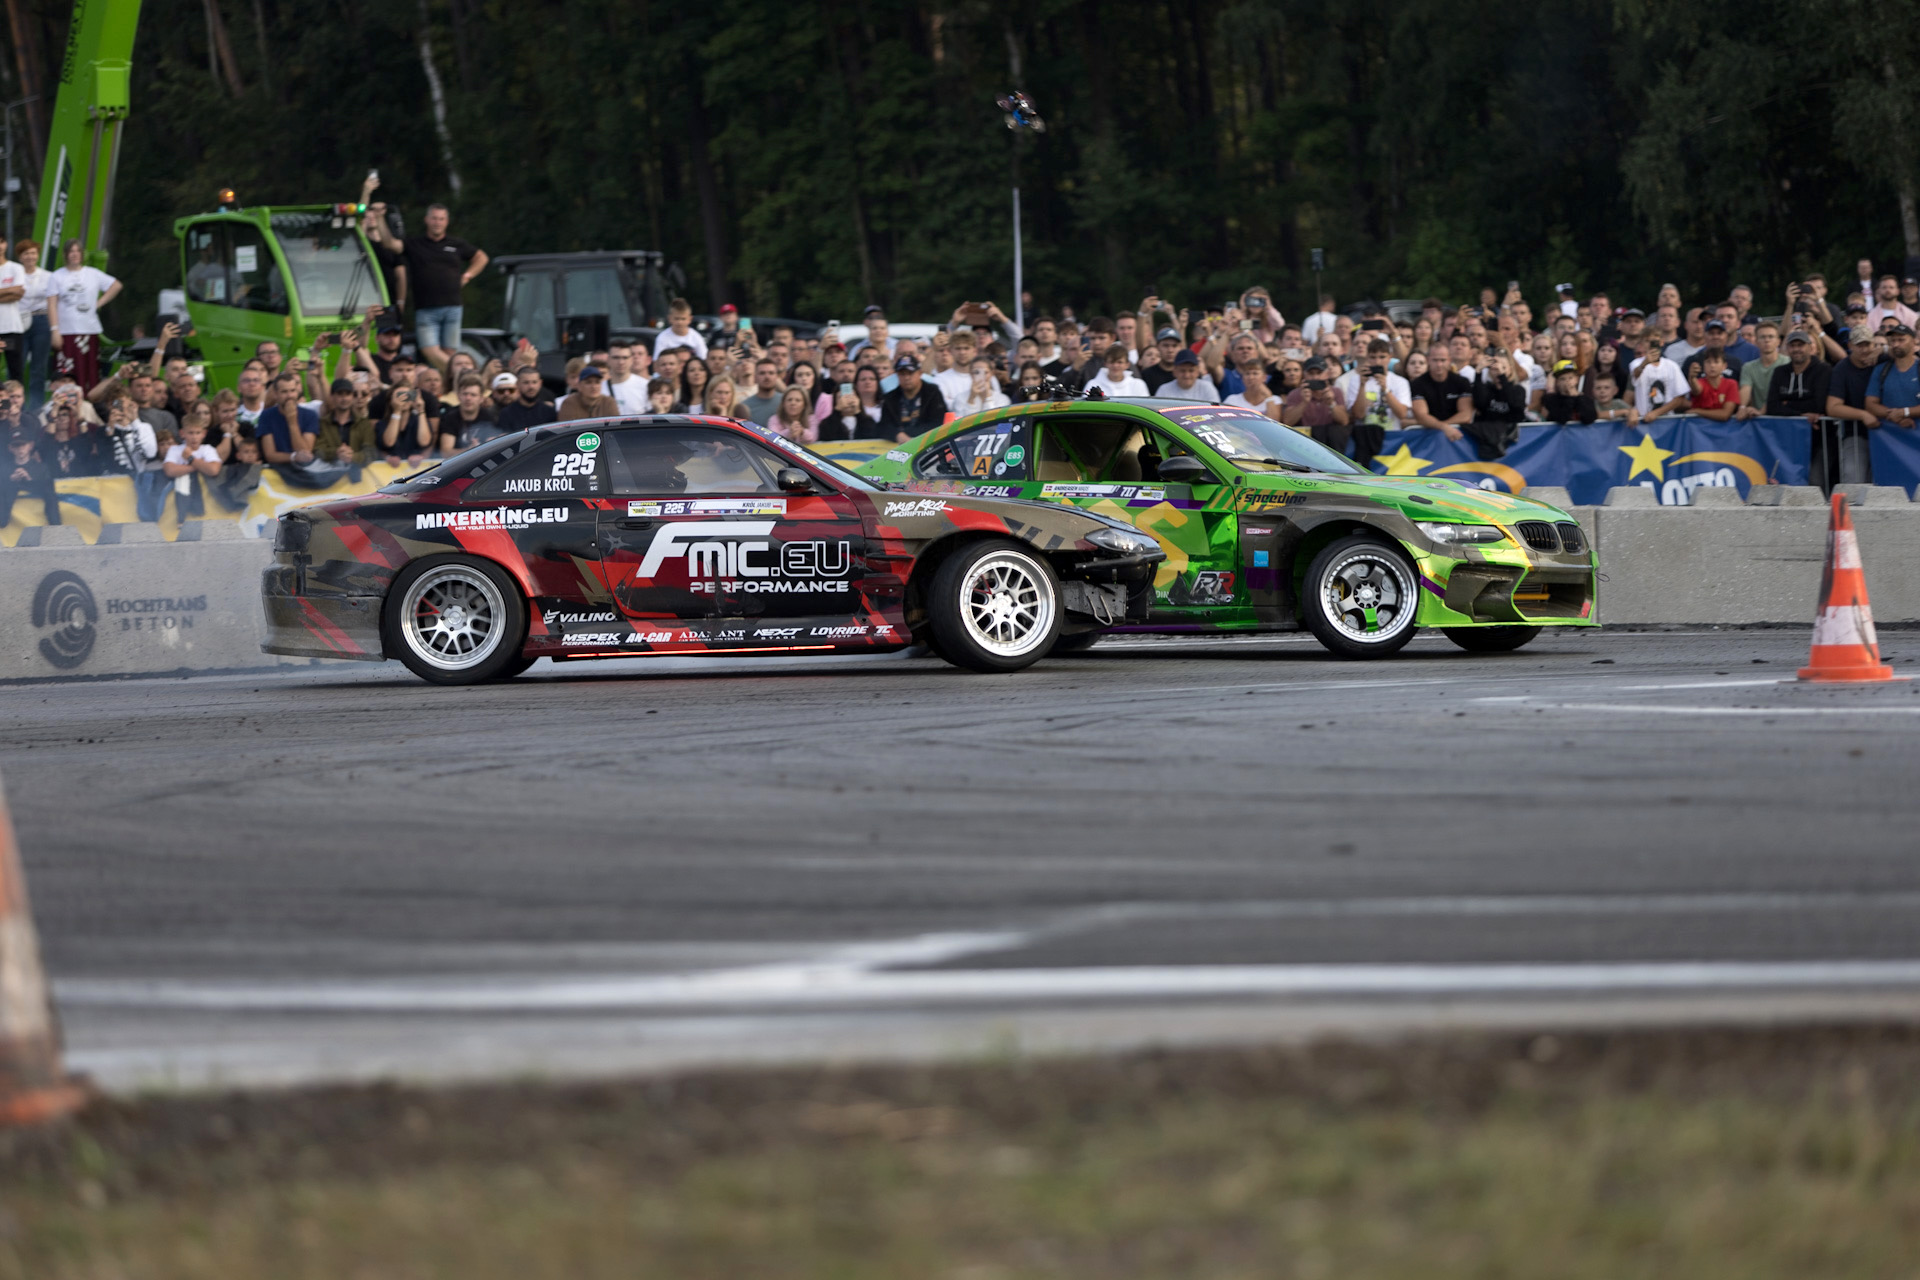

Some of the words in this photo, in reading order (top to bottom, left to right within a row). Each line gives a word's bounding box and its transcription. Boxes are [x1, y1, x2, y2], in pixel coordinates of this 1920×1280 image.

[579, 438, 598, 447] E85
[1198, 430, 1232, 446] 717
[973, 433, 1008, 456] 717
[1007, 451, 1022, 460] E85
[552, 452, 597, 476] 225
[974, 458, 987, 473] A
[502, 479, 541, 493] JAKUB
[544, 476, 575, 491] KRÓL
[976, 485, 1010, 497] FEAL
[1120, 487, 1137, 497] 717
[664, 502, 686, 514] 225
[416, 505, 569, 530] MIXERKING.EU
[690, 580, 850, 594] PERFORMANCE
[106, 595, 208, 614] HOCHTRANS
[121, 614, 194, 631] BETON
[560, 612, 615, 622] VALINO
[679, 630, 746, 639] ADAANT
[810, 626, 869, 636] LOVRIDE
[562, 633, 621, 642] MSPEK
[625, 632, 673, 643] AN-CAR
